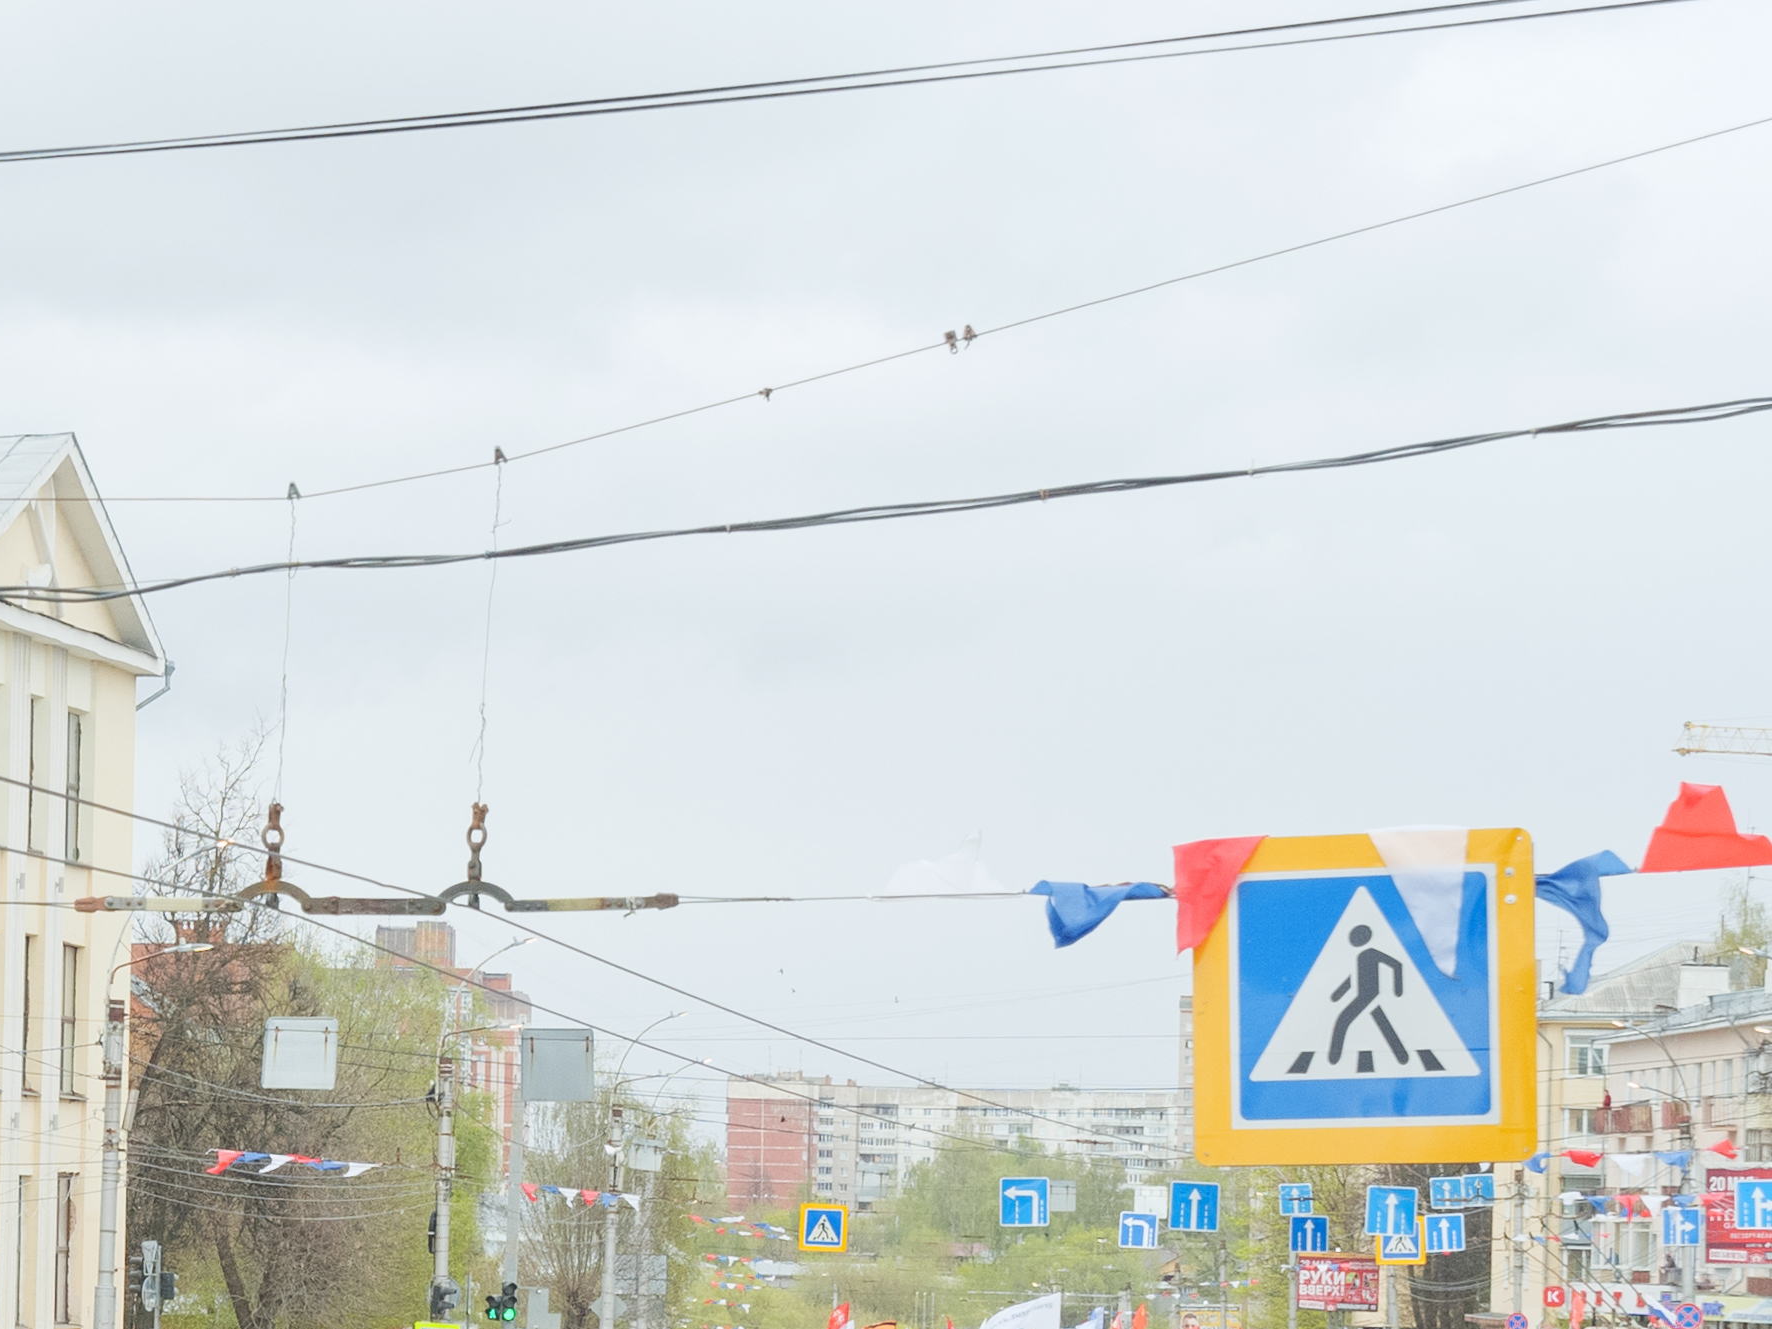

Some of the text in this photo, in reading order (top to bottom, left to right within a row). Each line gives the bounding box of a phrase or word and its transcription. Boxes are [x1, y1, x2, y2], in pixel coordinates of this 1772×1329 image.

[1709, 1176, 1726, 1191] 20
[1299, 1270, 1345, 1285] РУКИ
[1299, 1284, 1345, 1297] ВВЕРХ!
